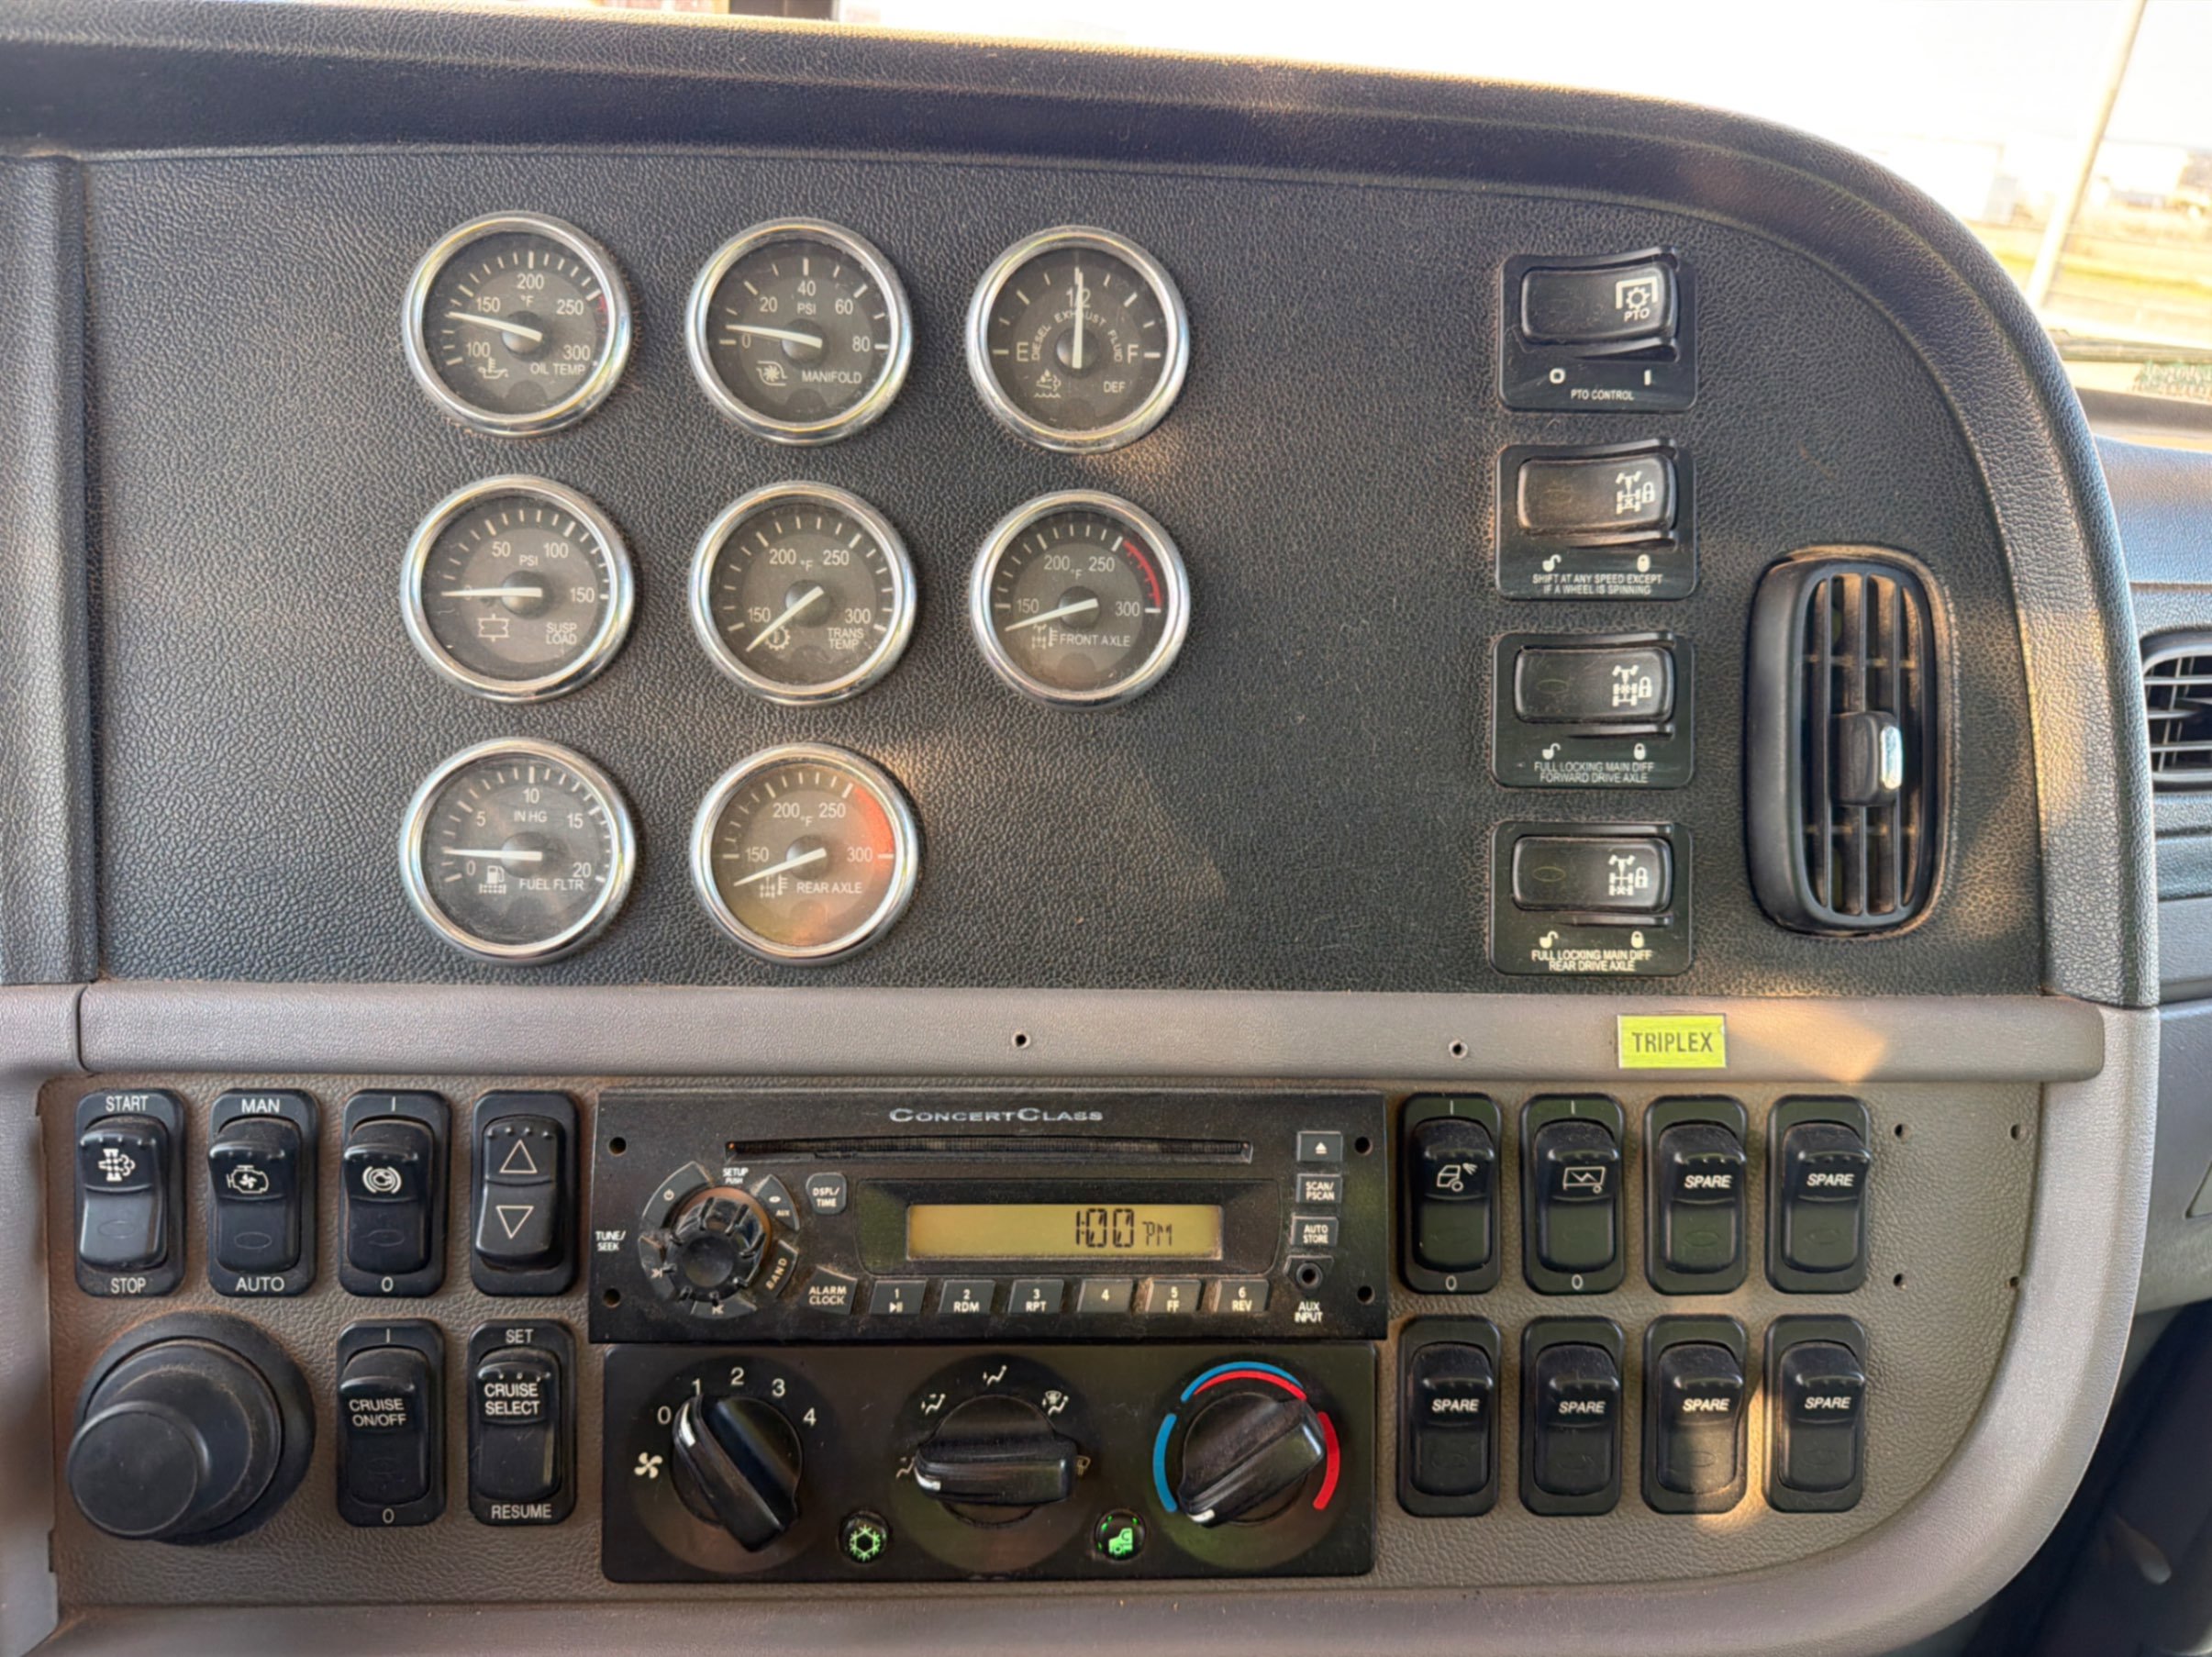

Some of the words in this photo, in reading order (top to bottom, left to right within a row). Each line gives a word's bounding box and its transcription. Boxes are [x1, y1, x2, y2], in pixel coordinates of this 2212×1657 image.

[517, 273, 544, 289] 200
[797, 281, 816, 296] 40
[477, 297, 500, 312] 150
[556, 300, 584, 315] 250
[760, 297, 777, 312] 20
[797, 303, 817, 315] PSI
[836, 299, 853, 315] 60
[1624, 308, 1650, 322] PTO
[1031, 325, 1051, 361] DIESEL
[1054, 310, 1106, 327] EXHUST
[1107, 329, 1123, 362] FLUID
[467, 342, 490, 356] 100
[852, 336, 871, 351] 80
[563, 346, 590, 361] 300
[1017, 341, 1029, 361] E
[1127, 344, 1139, 363] F
[530, 362, 549, 374] OIL
[553, 362, 585, 374] TEMP
[802, 370, 861, 384] MANIFOLD
[1104, 381, 1126, 393] DEF
[1571, 390, 1589, 400] PTO
[1592, 390, 1635, 400] CONTROL
[492, 541, 510, 557] 50
[544, 542, 569, 558] 100
[519, 554, 539, 566] PSI
[770, 549, 796, 564] 200
[823, 550, 850, 565] 250
[1044, 555, 1070, 570] 200
[1089, 556, 1115, 572] 250
[1533, 574, 1559, 584] SHIFT
[1561, 574, 1573, 584] AT
[1574, 574, 1592, 584] ANY
[1594, 574, 1624, 584] SPEED
[1628, 574, 1663, 584] EXCEPT
[571, 587, 595, 603] 150
[1544, 585, 1551, 594] IF
[1554, 585, 1560, 594] A
[1563, 585, 1595, 595] WHEEL
[1597, 585, 1606, 595] IS
[1608, 585, 1651, 595] SPINNING
[1017, 599, 1039, 614] 150
[1116, 602, 1140, 617] 300
[749, 607, 771, 622] 150
[845, 608, 871, 624] 300
[547, 623, 577, 634] SUSP
[828, 628, 864, 639] TRANS
[547, 633, 576, 644] LOAD
[828, 639, 859, 650] TEMP
[1060, 635, 1098, 646] FRONT
[1102, 636, 1130, 647] AXLE
[1534, 762, 1557, 772] FULL
[1560, 762, 1603, 772] LOCKING
[1606, 762, 1630, 772] MAIN
[1632, 762, 1654, 772] DIFF
[1540, 773, 1588, 783] FORWARD
[1591, 773, 1621, 783] DRIVE
[1623, 773, 1648, 783] AXLE
[524, 788, 539, 804] 10
[514, 811, 528, 822] IN
[529, 810, 547, 822] HG
[773, 803, 800, 817] 200
[819, 803, 846, 817] 250
[477, 811, 485, 827] 5
[568, 813, 583, 828] 15
[746, 848, 769, 862] 150
[847, 847, 873, 862] 300
[466, 861, 475, 875] 0
[573, 862, 591, 878] 20
[519, 879, 549, 890] FUEL
[553, 880, 584, 891] FLTR
[796, 883, 829, 894] REAR
[832, 883, 862, 894] AXLE
[1531, 950, 1553, 961] FULL
[1557, 950, 1601, 960] LOCKING
[1604, 950, 1628, 960] MAIN
[1629, 950, 1652, 960] DIFF
[1550, 961, 1576, 971] REAR
[1578, 962, 1608, 971] DRIVE
[1610, 962, 1635, 972] AXLE
[1632, 1032, 1713, 1052] TRIPLEX
[106, 1095, 149, 1112] START
[241, 1099, 280, 1113] MAN
[723, 1168, 749, 1177] SETUP
[1806, 1173, 1854, 1186] SPARE
[1306, 1182, 1334, 1191] SCAN/
[1684, 1175, 1732, 1189] SPARE
[1076, 1208, 1134, 1248] 1:00
[1142, 1221, 1173, 1246] PM
[1305, 1225, 1328, 1234] AUTO
[595, 1231, 627, 1240] TUNE/
[1304, 1234, 1328, 1243] STORE
[597, 1242, 620, 1251] SEEK
[111, 1277, 146, 1294] STOP
[236, 1276, 284, 1291] AUTO
[809, 1285, 847, 1296] ALARM
[895, 1288, 899, 1298] 1
[963, 1289, 970, 1299] 2
[1033, 1289, 1039, 1299] 3
[1102, 1289, 1109, 1300] 4
[1172, 1286, 1178, 1297] 5
[1239, 1287, 1246, 1297] 6
[809, 1296, 844, 1305] CLOCK
[954, 1302, 979, 1312] RDM
[1026, 1301, 1046, 1312] RPT
[1167, 1300, 1179, 1312] FF
[1232, 1300, 1251, 1311] REV
[1298, 1302, 1319, 1312] AUX
[1295, 1312, 1322, 1322] INPUT
[506, 1329, 534, 1343] SET
[731, 1367, 744, 1385] 2
[484, 1383, 539, 1397] CRUISE
[692, 1379, 701, 1395] 1
[773, 1378, 785, 1396] 3
[349, 1398, 404, 1411] CRUISE
[485, 1401, 540, 1415] SELECT
[1432, 1399, 1479, 1412] SPARE
[1559, 1401, 1606, 1414] SPARE
[1683, 1398, 1729, 1411] SPARE
[1805, 1397, 1851, 1409] SPARE
[352, 1414, 406, 1427] ON/OFF
[657, 1406, 671, 1424] 0
[804, 1408, 817, 1426] 4
[492, 1505, 551, 1518] RESUME
